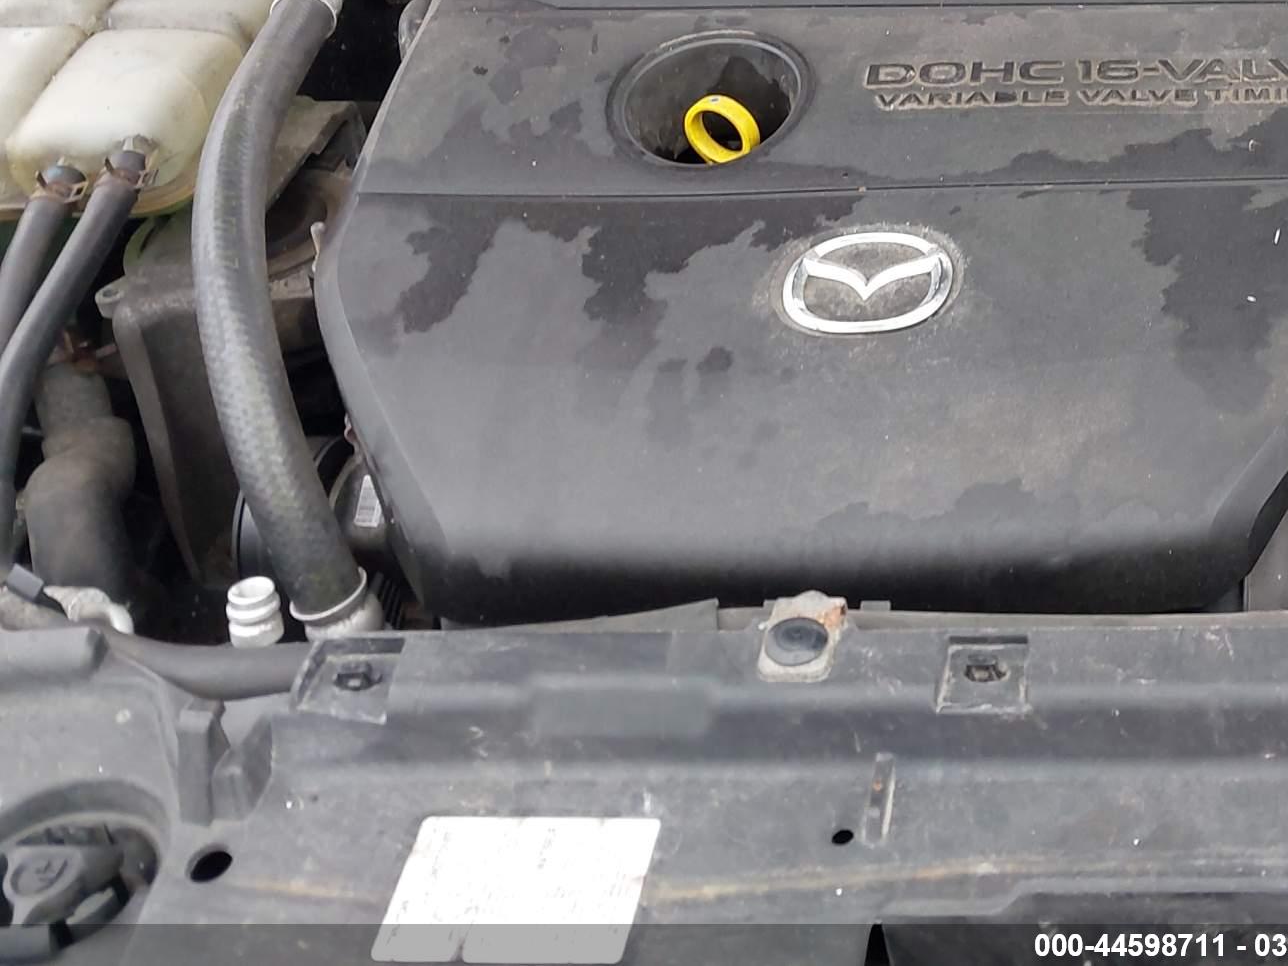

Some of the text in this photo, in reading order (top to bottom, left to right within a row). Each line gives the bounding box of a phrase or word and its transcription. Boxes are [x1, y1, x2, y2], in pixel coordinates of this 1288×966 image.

[864, 60, 1064, 86] DOHC
[876, 89, 1069, 109] VARIABLE
[1079, 88, 1198, 107] VALVE
